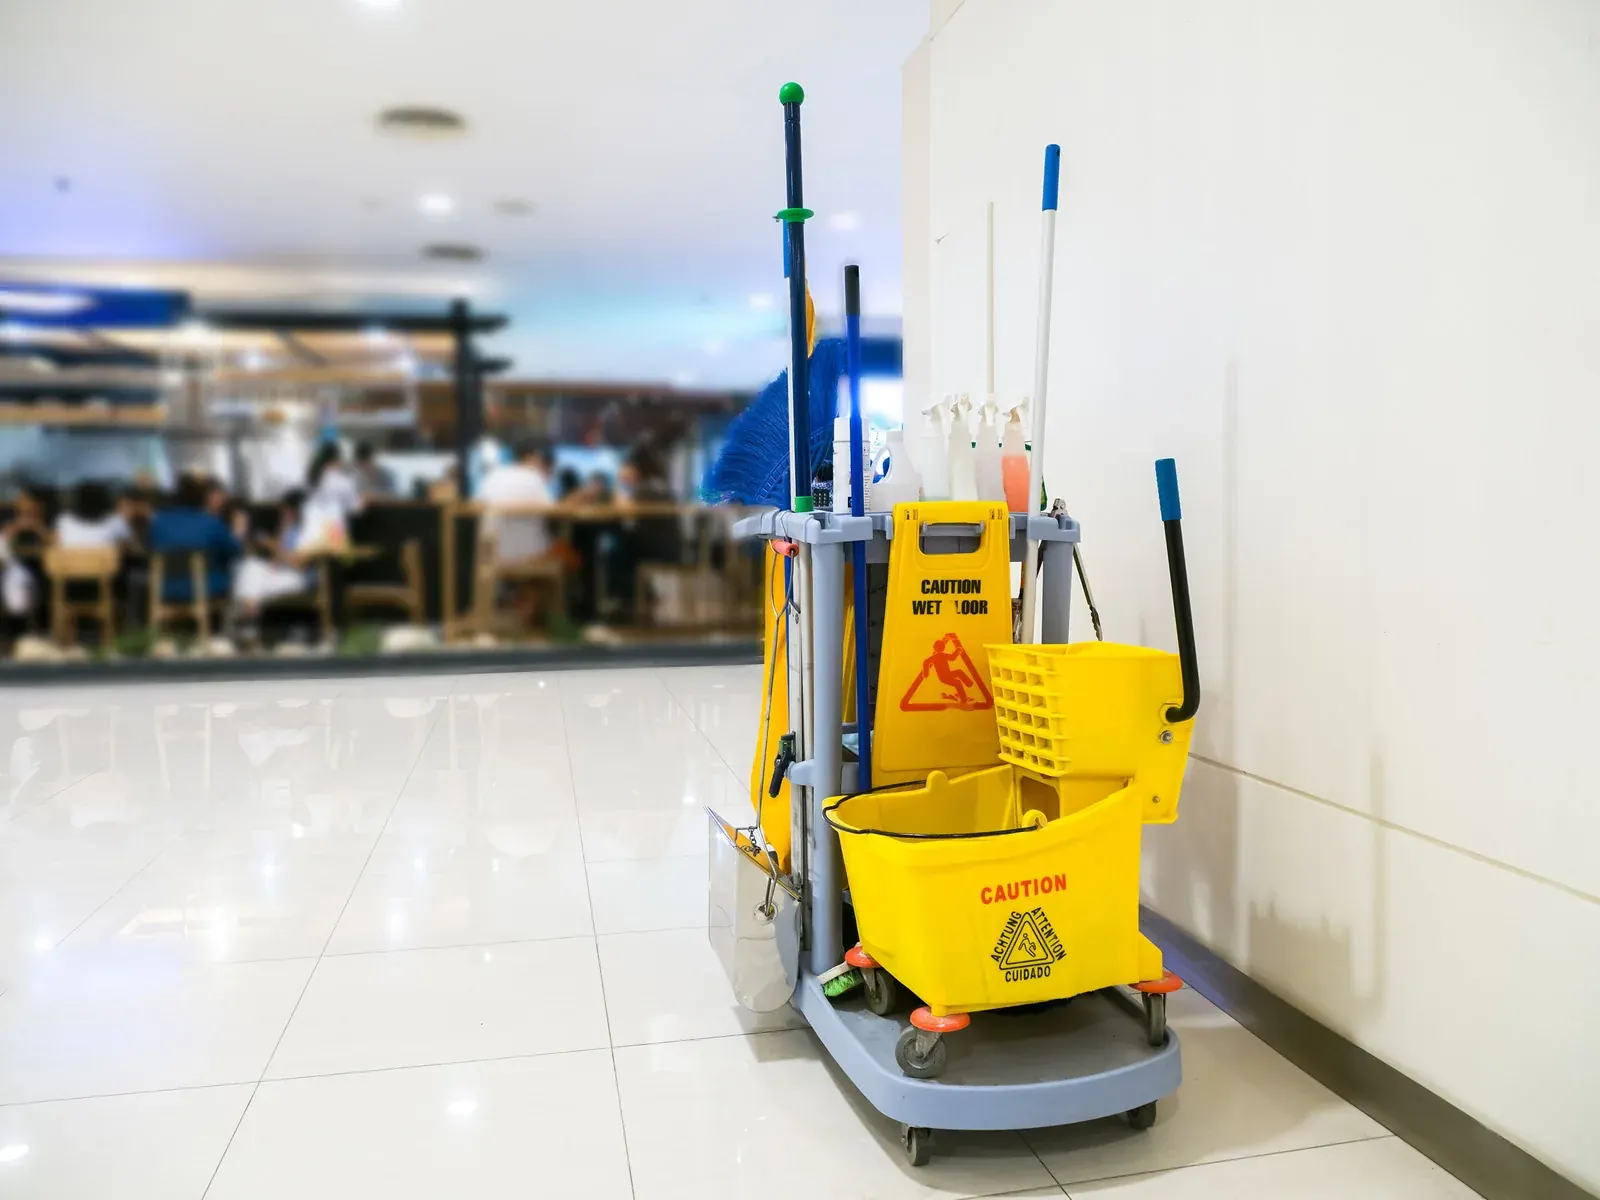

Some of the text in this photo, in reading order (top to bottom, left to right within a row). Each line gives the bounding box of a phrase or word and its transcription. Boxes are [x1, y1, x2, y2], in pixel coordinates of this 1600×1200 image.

[921, 579, 981, 594] CAUTION
[912, 600, 988, 615] WET LOOR
[981, 873, 1067, 905] CAUTION
[990, 911, 1022, 962] ACHTUNG
[1031, 907, 1067, 961] ATTENTION
[1005, 965, 1051, 982] CUIDADO
